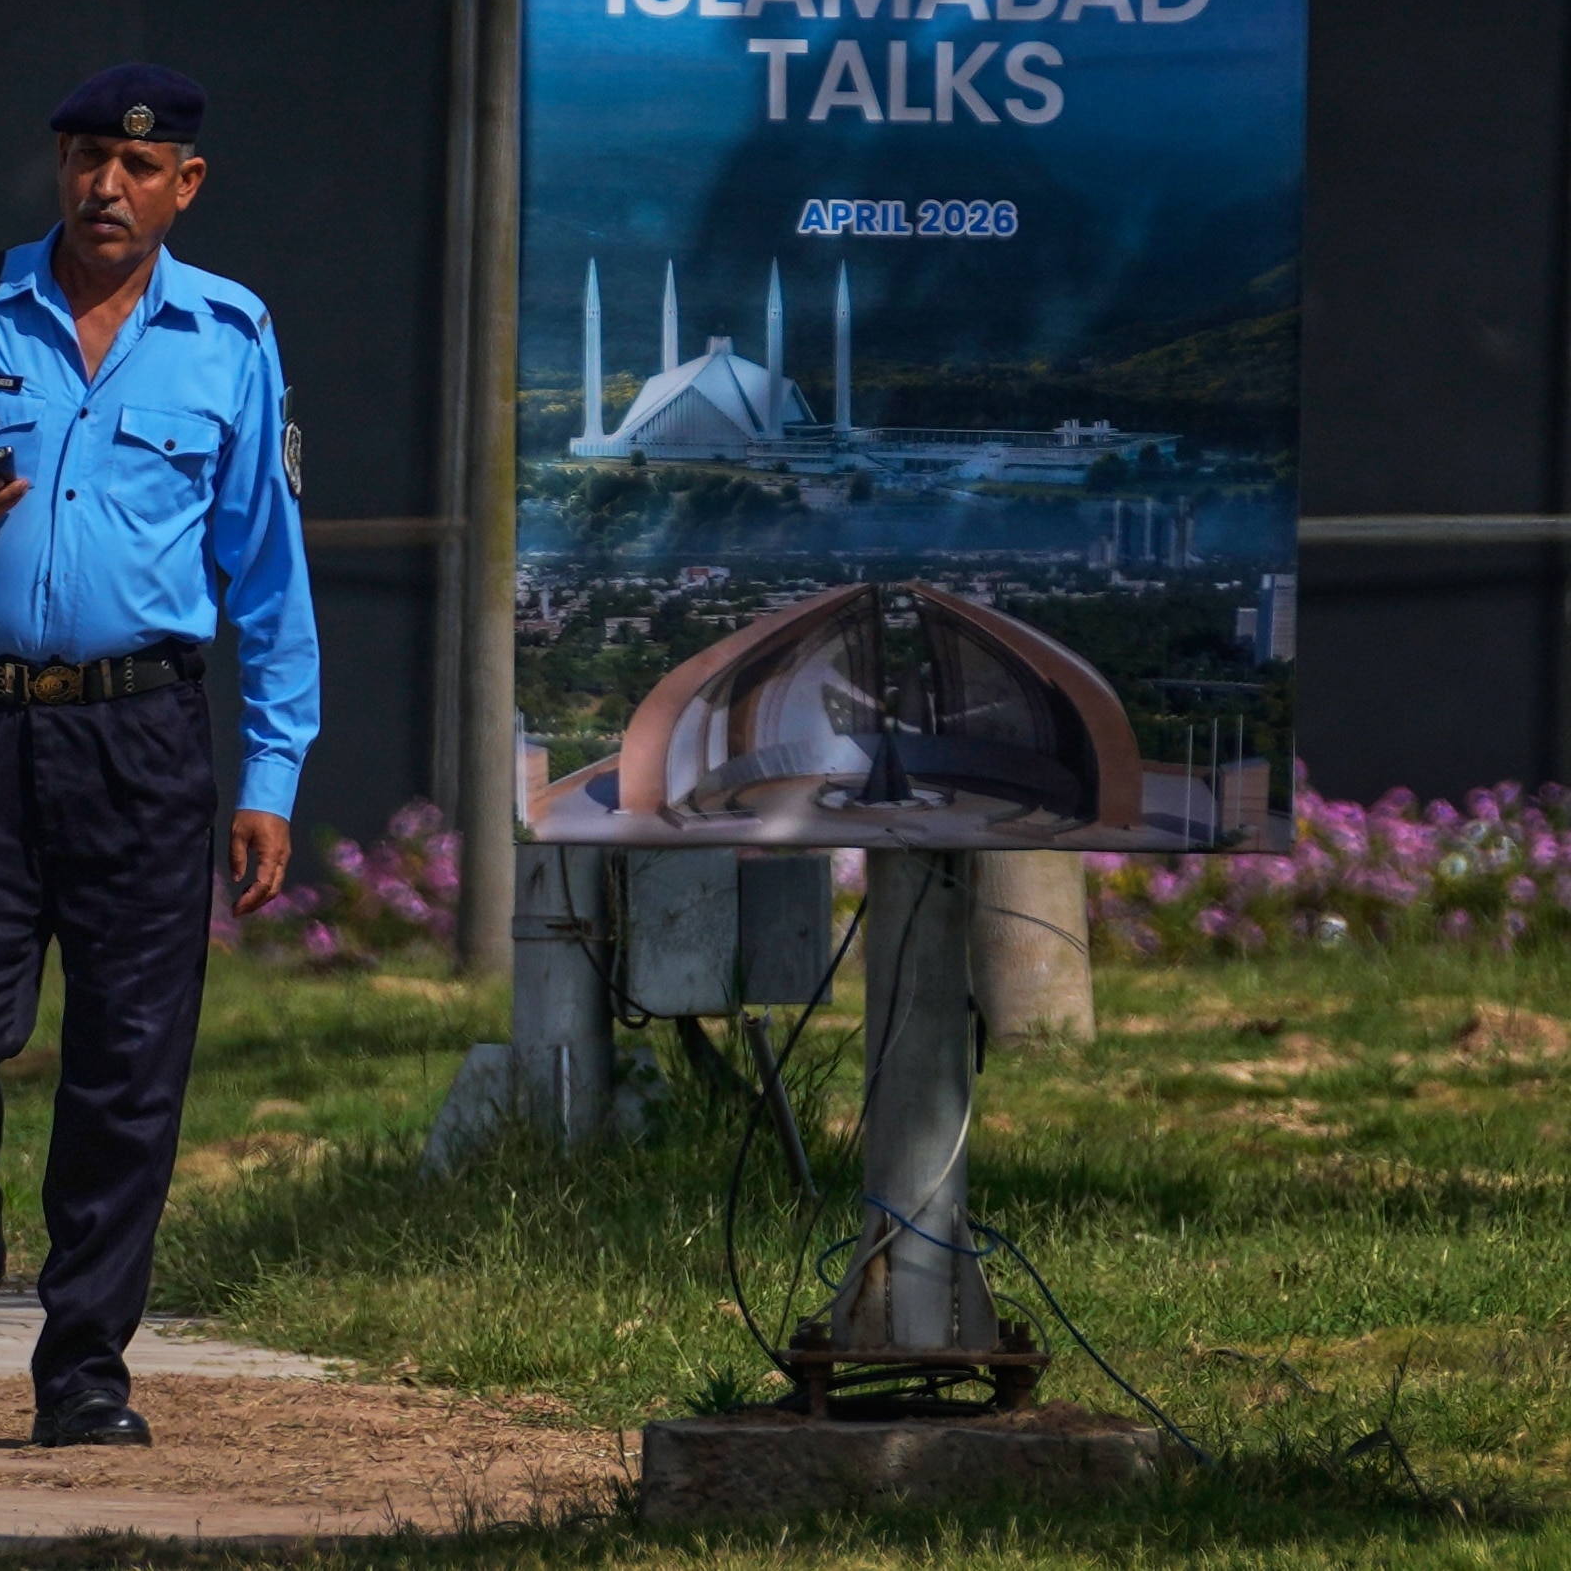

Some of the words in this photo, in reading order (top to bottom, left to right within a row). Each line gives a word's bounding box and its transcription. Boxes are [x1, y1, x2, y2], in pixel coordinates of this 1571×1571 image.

[748, 38, 1066, 124] TALKS
[798, 199, 913, 236] APRIL
[917, 199, 1018, 237] 2026
